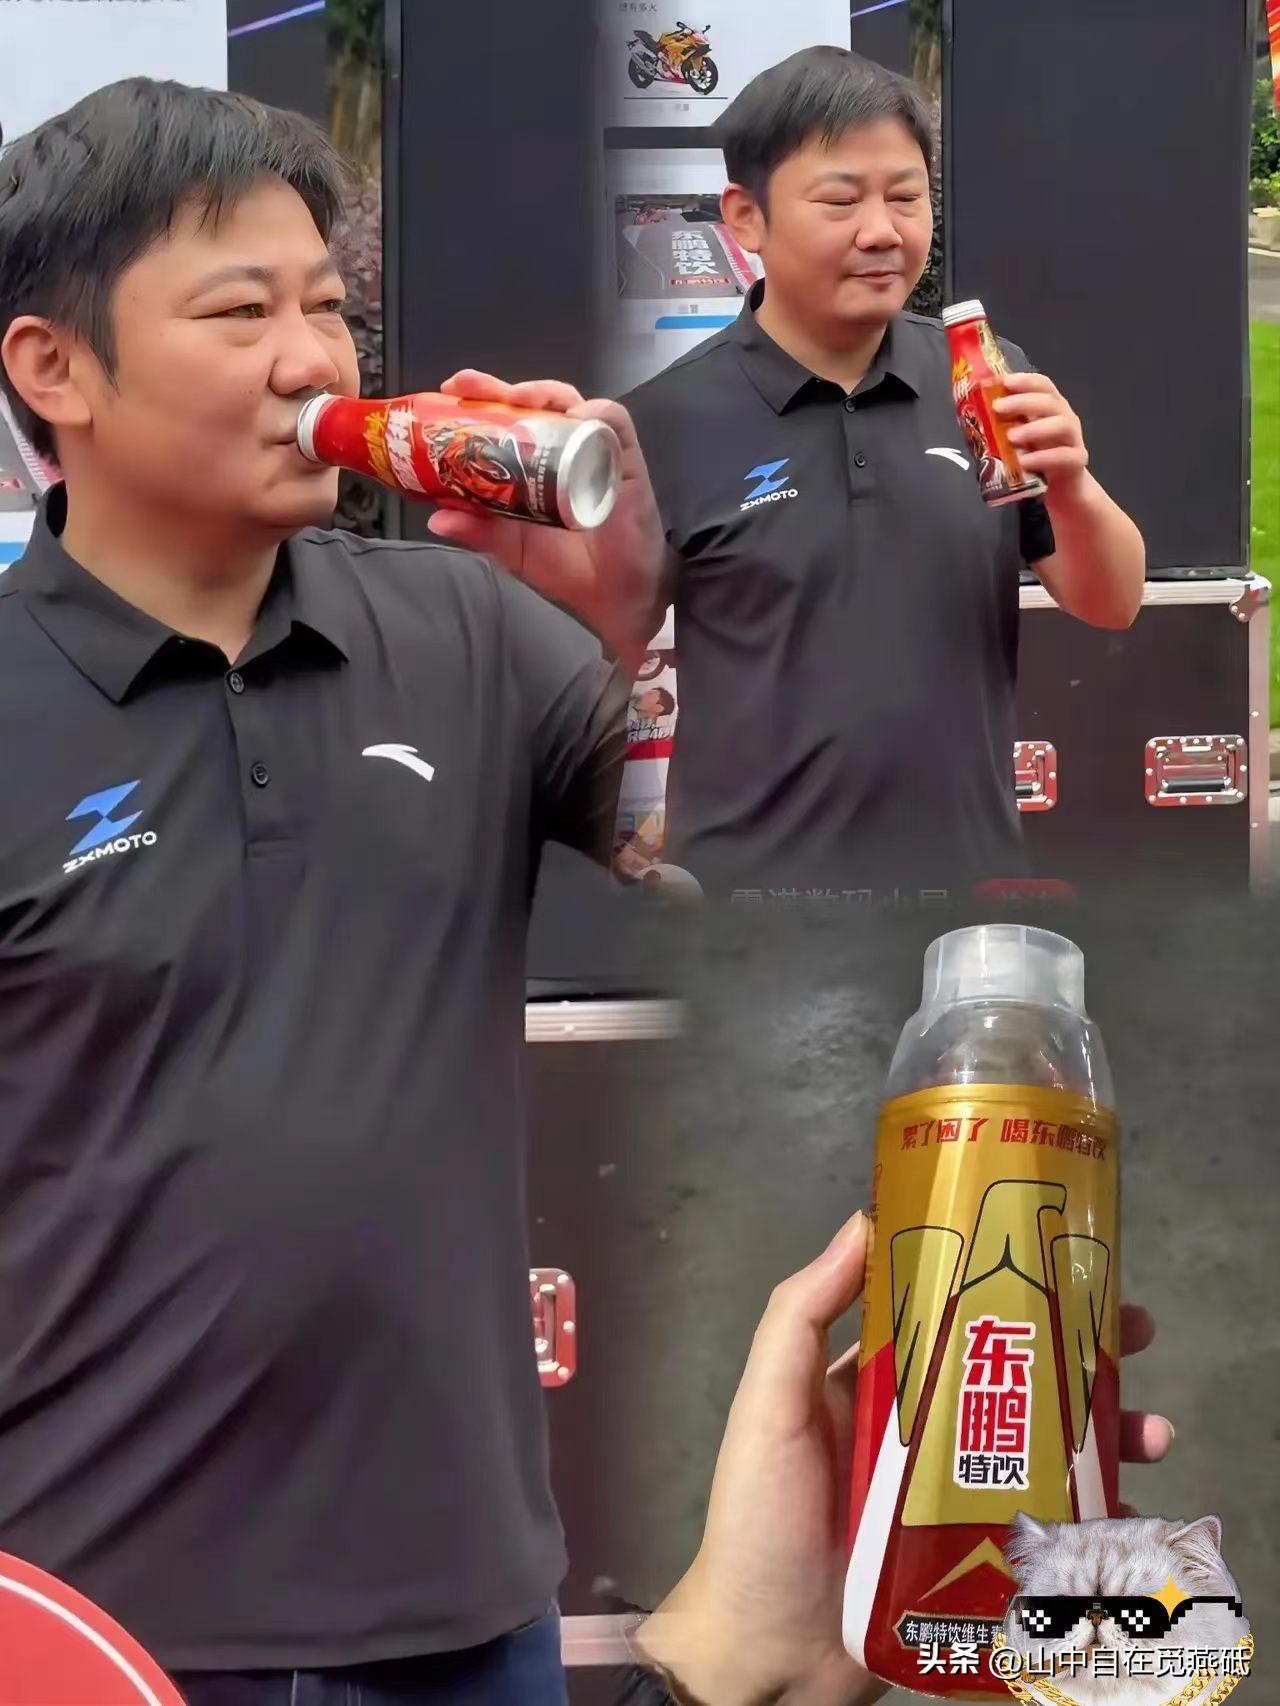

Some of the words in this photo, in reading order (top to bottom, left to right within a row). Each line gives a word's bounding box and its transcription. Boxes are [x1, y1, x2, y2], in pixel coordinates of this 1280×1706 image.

[740, 488, 798, 511] ZXMOTO
[62, 830, 157, 874] ZXMOTO
[901, 1117, 989, 1150] 累了困了
[1000, 1118, 1108, 1160] 喝东鹏特饮
[958, 1454, 1025, 1486] 特饮
